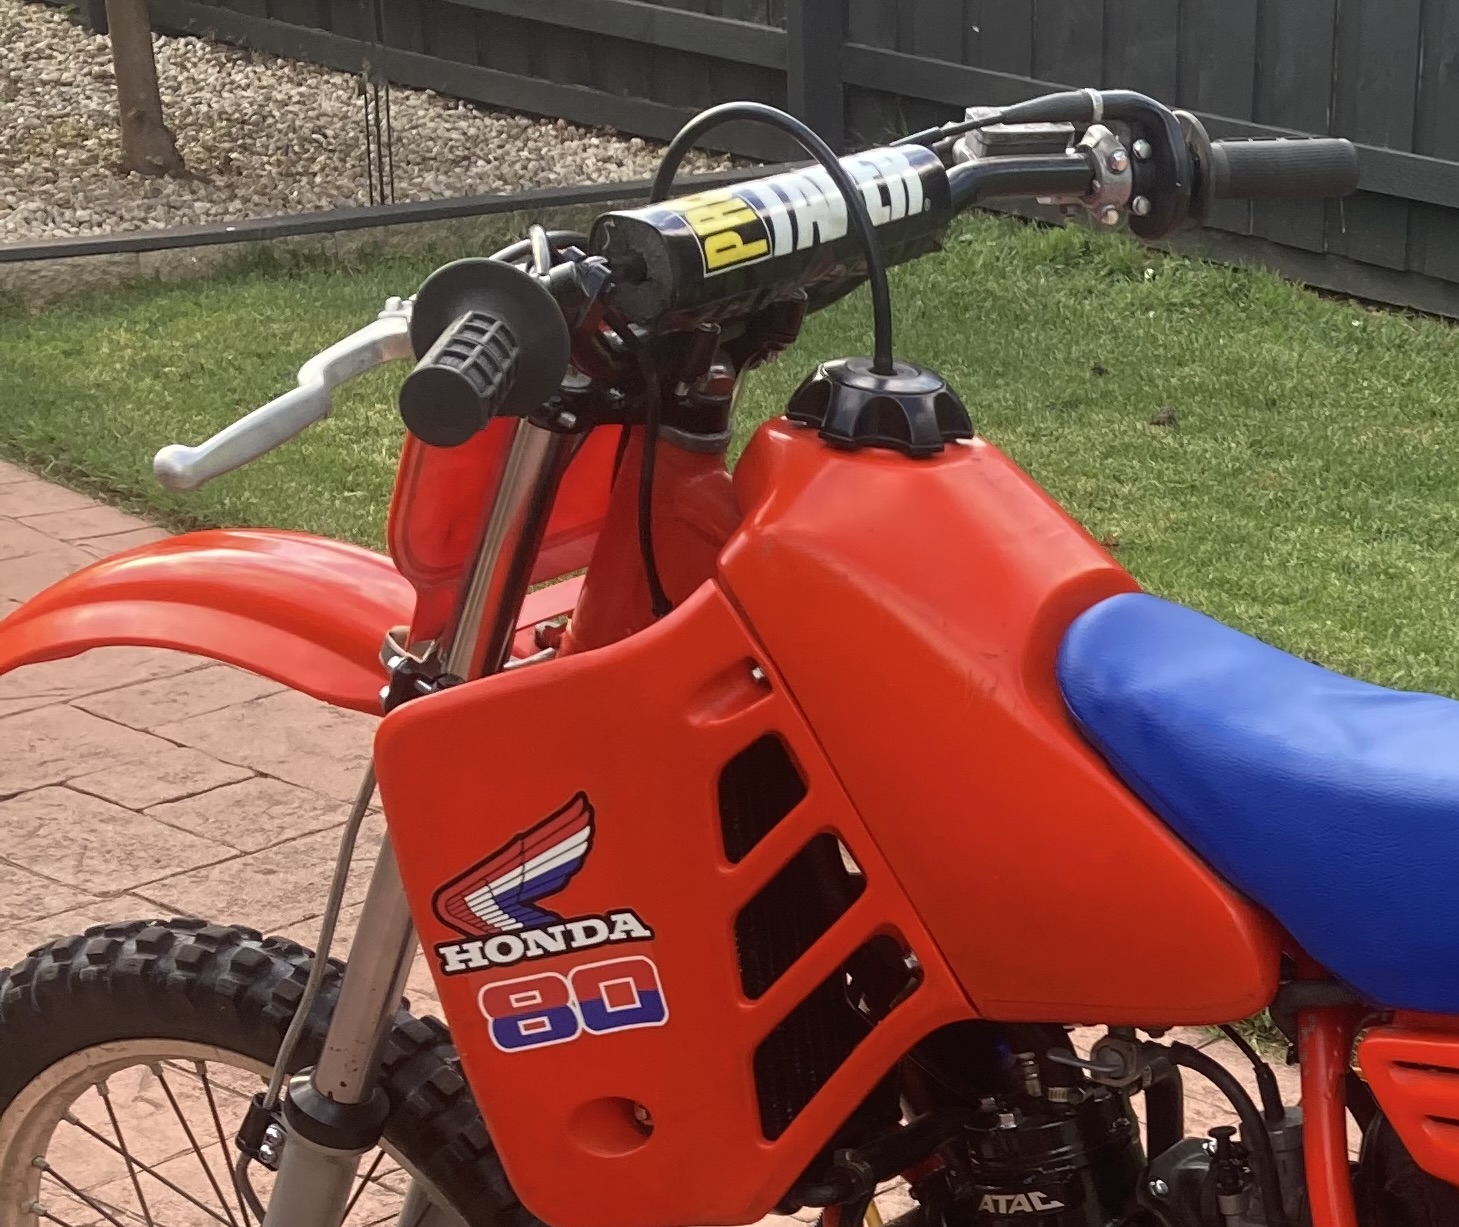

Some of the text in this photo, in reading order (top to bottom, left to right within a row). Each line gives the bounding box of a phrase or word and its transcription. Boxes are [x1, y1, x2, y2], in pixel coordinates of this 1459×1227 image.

[437, 910, 653, 974] HONDA
[478, 955, 669, 1053] 80
[979, 1191, 1065, 1214] ATAC
